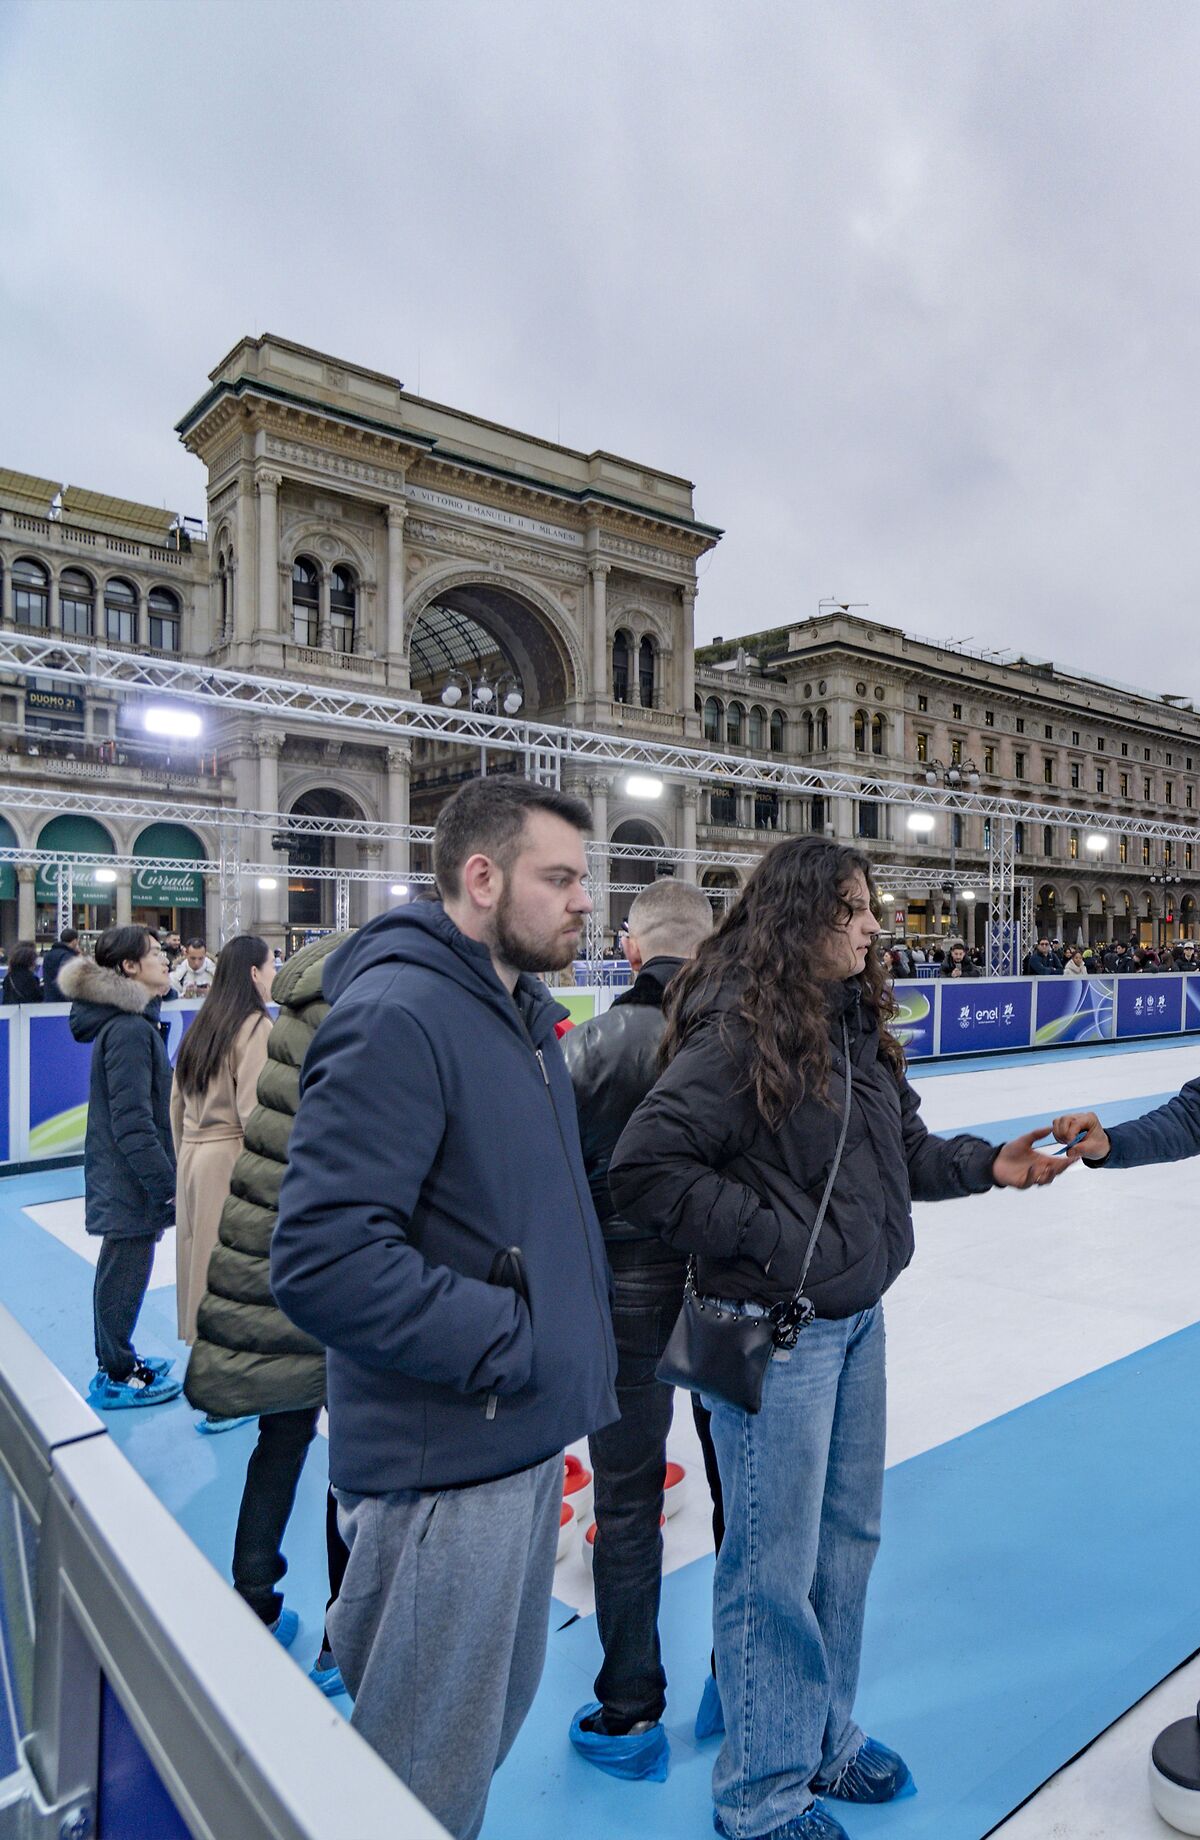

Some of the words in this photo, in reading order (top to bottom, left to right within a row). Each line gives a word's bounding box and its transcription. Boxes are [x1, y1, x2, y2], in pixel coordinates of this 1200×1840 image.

[409, 489, 416, 497] A
[421, 492, 463, 510] VITTORIO
[467, 506, 513, 525] EMANUELE
[539, 525, 577, 542] MILANESI
[30, 693, 64, 706] DUOMO
[66, 699, 76, 708] 21
[975, 1007, 998, 1020] enel
